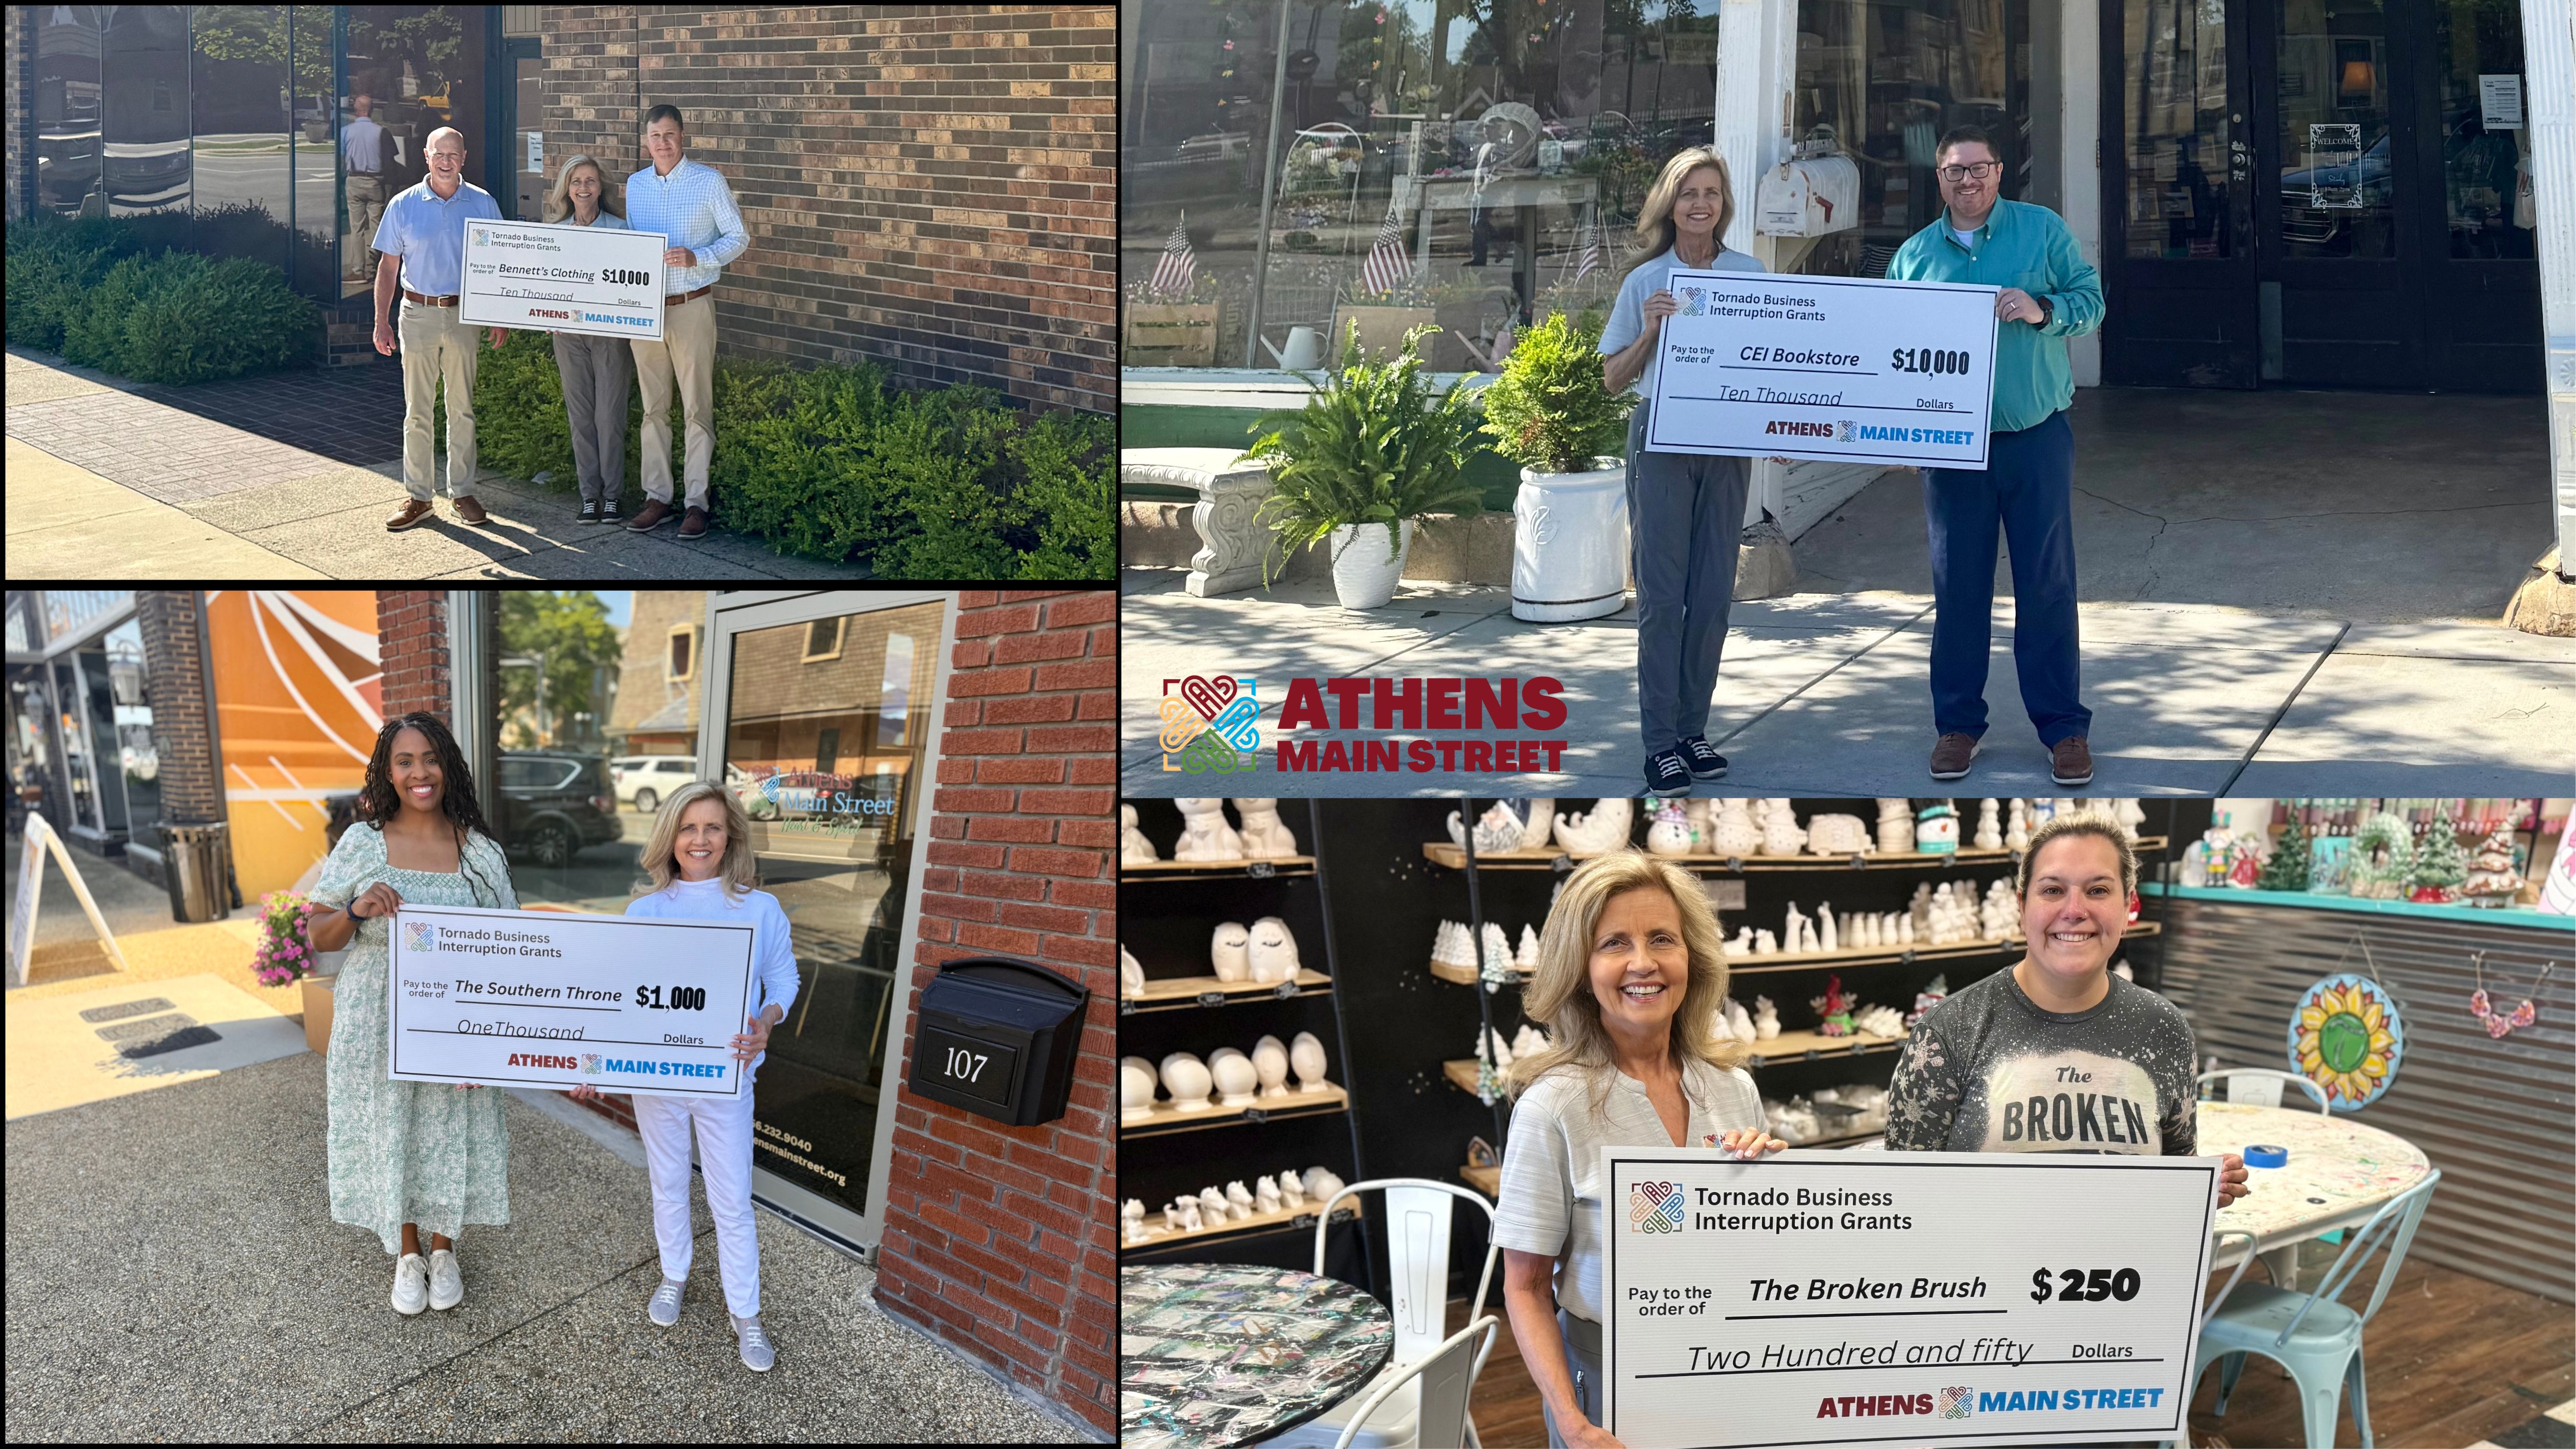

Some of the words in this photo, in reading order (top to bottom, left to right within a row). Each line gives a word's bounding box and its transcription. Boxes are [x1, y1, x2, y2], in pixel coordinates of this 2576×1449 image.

[491, 240, 535, 250] Interruption
[492, 232, 521, 240] Tornado
[523, 234, 554, 243] Business
[551, 268, 595, 282] Clothing
[602, 269, 650, 288] $10,000
[500, 287, 518, 297] Ten
[522, 288, 573, 302] Thousand
[1712, 291, 1760, 305] Tornado
[1764, 294, 1815, 307] Business
[528, 309, 569, 319] ATHENS
[585, 313, 614, 323] MAIN
[615, 315, 654, 327] STREET
[1710, 305, 1783, 319] Interruption
[1786, 309, 1825, 321] Grants
[1671, 345, 1687, 356] Pay
[1689, 346, 1697, 354] to
[1698, 346, 1715, 355] the
[1675, 354, 1698, 363] order
[1700, 355, 1711, 363] of
[1740, 346, 1769, 362] CEI
[1773, 348, 1859, 366] Bookstore
[1891, 348, 1969, 381] $10,000
[1720, 385, 1749, 402] Ten
[1756, 387, 1842, 406] Thousand
[1916, 398, 1954, 410] Dollars
[1765, 421, 1833, 437] ATHENS
[1860, 425, 1910, 442] MAIN
[1912, 428, 1974, 445] STREET
[785, 767, 853, 790] Athens
[783, 792, 827, 812] Main
[833, 792, 896, 816] Street
[781, 816, 809, 833] Heart
[811, 814, 823, 833] &
[439, 927, 491, 941] Tornado
[494, 930, 550, 944] Business
[439, 941, 516, 956] Interruption
[520, 946, 562, 958] Grants
[403, 980, 420, 991] Pay
[432, 981, 448, 990] the
[409, 989, 434, 998] order
[435, 990, 445, 998] of
[455, 980, 483, 994] The
[487, 982, 561, 999] Southern
[566, 986, 622, 1002] Throne
[635, 985, 706, 1014] $1,000
[664, 1033, 704, 1045] Dollars
[508, 1053, 578, 1070] ATHENS
[606, 1059, 657, 1075] MAIN
[658, 1062, 726, 1078] STREET
[944, 1047, 988, 1083] 107
[2055, 1065, 2092, 1083] The
[2003, 1093, 2148, 1144] BROKEN
[753, 1137, 846, 1187] ensmainstreet.org
[1695, 1188, 1789, 1207] Tornado
[1796, 1188, 1893, 1207] Business
[1695, 1211, 1834, 1234] Interruption
[1841, 1211, 1912, 1231] Grants
[1628, 1287, 1659, 1304] Pay
[1663, 1288, 1678, 1300] to
[1682, 1285, 1713, 1300] the
[1750, 1279, 1798, 1302] The
[1806, 1278, 1903, 1300] Broken
[1909, 1276, 1987, 1299] Brush
[1638, 1301, 1685, 1316] order
[1688, 1301, 1706, 1315] of
[1687, 1346, 1751, 1371] Two
[1761, 1341, 1896, 1369] Hundred
[1906, 1339, 1963, 1365] and
[1972, 1337, 2034, 1367] fifty
[2071, 1343, 2133, 1360] Dollars
[1816, 1394, 1934, 1419] ATHENS
[1979, 1389, 2059, 1413] MAIN
[2061, 1388, 2164, 1411] STREET
